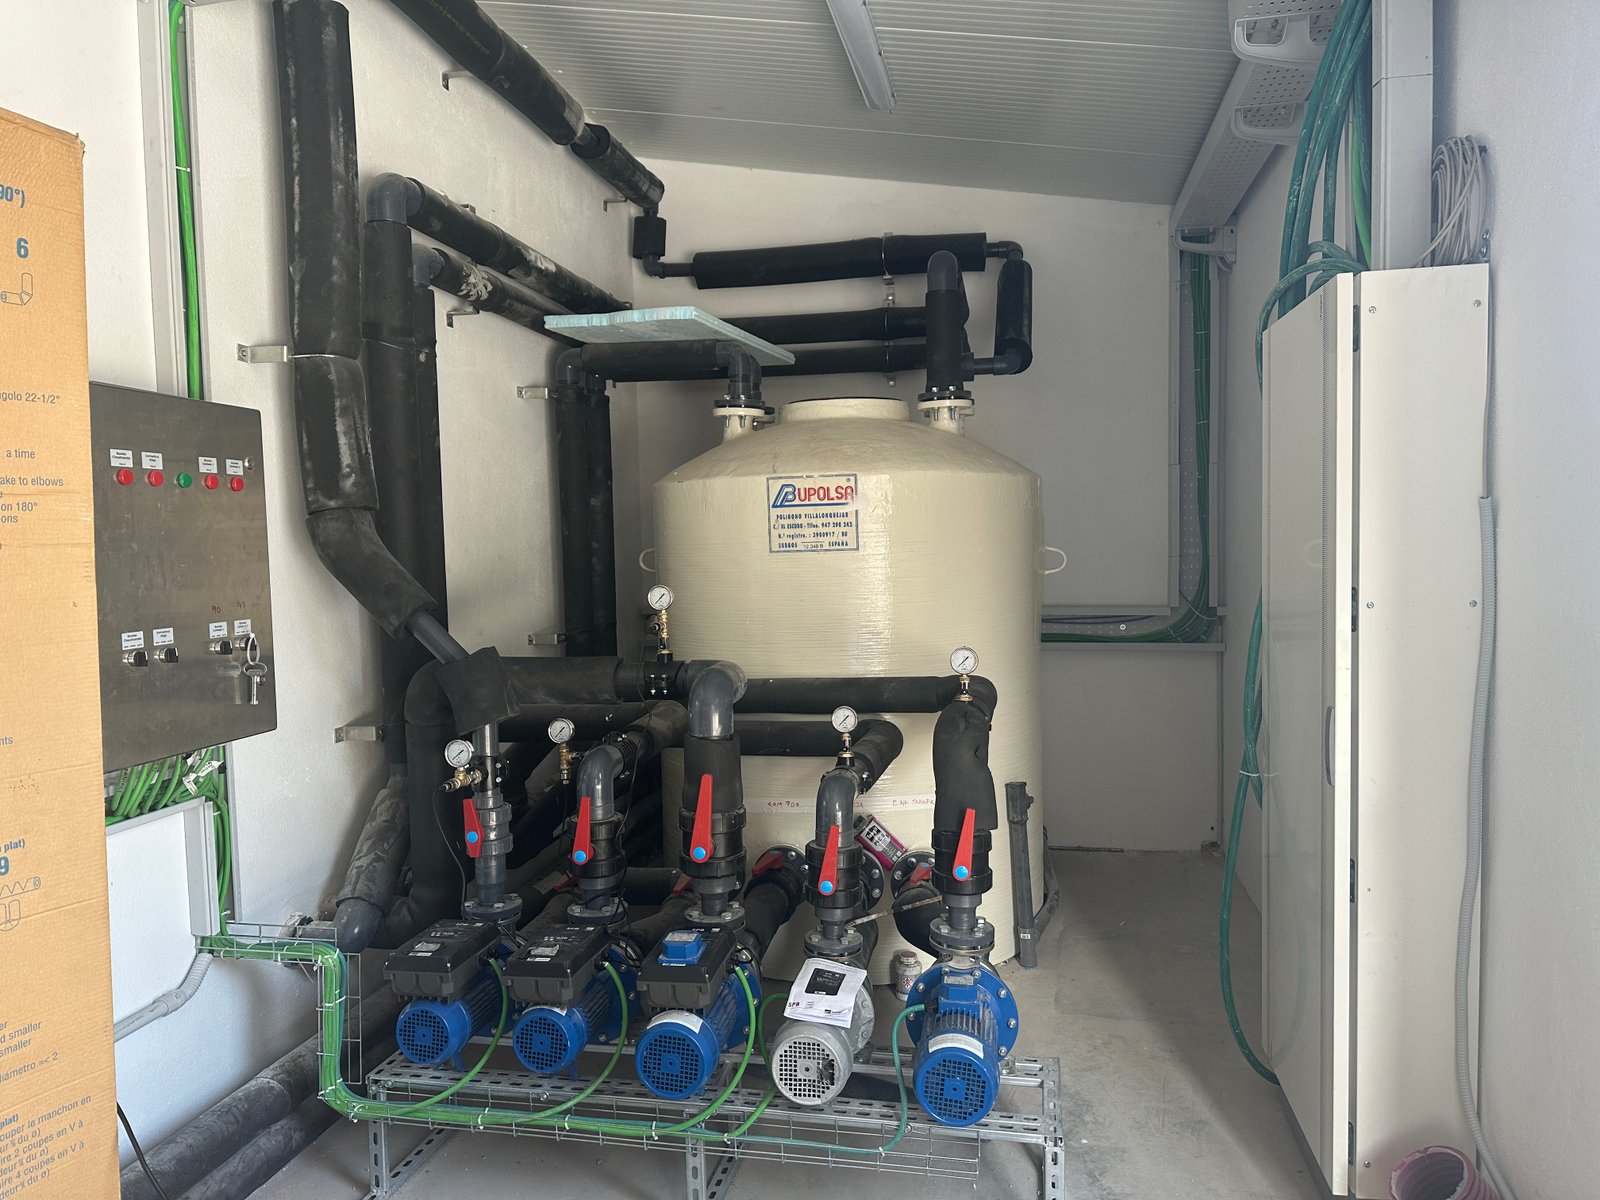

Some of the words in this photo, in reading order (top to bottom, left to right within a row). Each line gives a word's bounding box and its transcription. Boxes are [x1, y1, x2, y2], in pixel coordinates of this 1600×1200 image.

[16, 237, 29, 259] 6
[0, 391, 22, 402] golo
[25, 392, 60, 404] 22-1/2°
[6, 449, 12, 458] a
[14, 448, 36, 459] time
[19, 476, 28, 486] to
[31, 476, 64, 487] elbows
[16, 501, 38, 512] 180°
[0, 515, 18, 523] ons
[4, 838, 25, 853] plat)
[0, 856, 9, 876] 9
[8, 1021, 41, 1040] smaller
[52, 1051, 58, 1061] 2
[27, 1119, 36, 1129] le
[37, 1100, 79, 1124] manchon
[80, 1095, 92, 1106] en
[14, 1148, 20, 1158] 2
[22, 1133, 54, 1154] coupes
[56, 1127, 67, 1138] en
[69, 1122, 76, 1132] V
[17, 1134, 29, 1145] du
[23, 1155, 56, 1176] coupes
[57, 1149, 68, 1159] en
[70, 1143, 77, 1152] V
[25, 1153, 37, 1164] du
[27, 1175, 39, 1186] du
